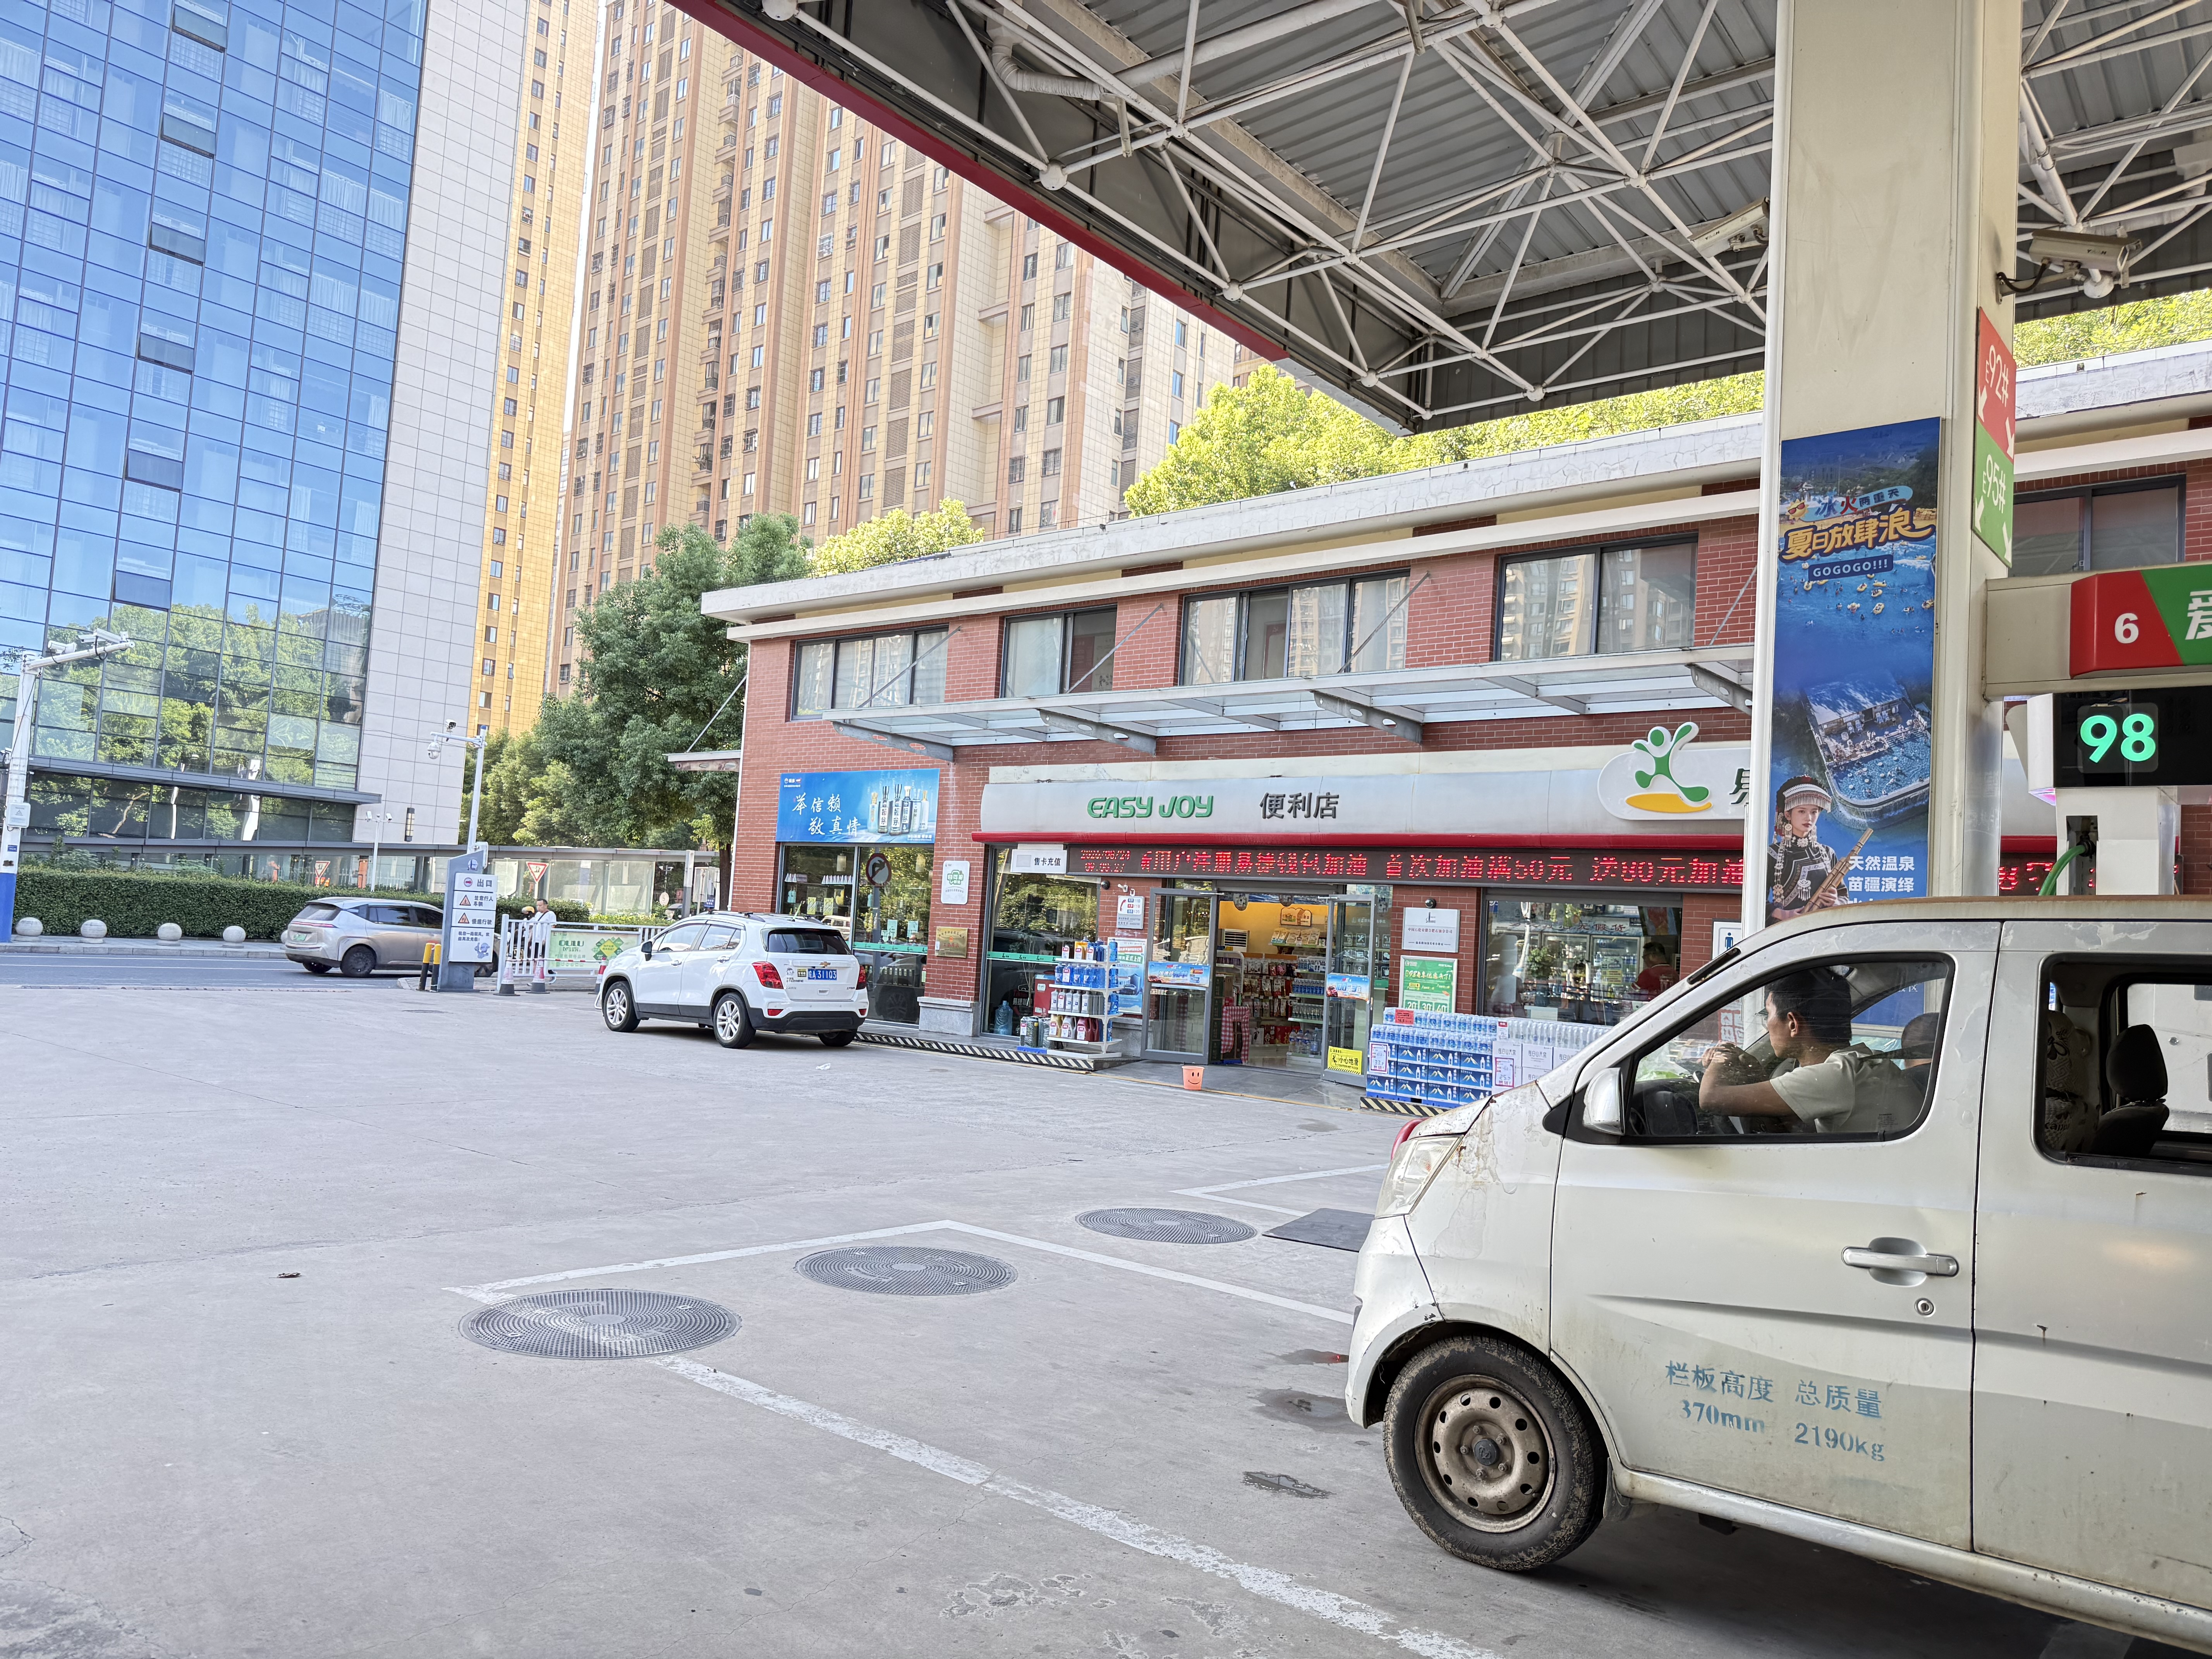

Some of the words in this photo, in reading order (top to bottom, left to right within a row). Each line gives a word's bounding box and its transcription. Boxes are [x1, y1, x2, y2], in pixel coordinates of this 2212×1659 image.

[1985, 345, 2009, 407] E92#
[1982, 454, 2006, 514] E95#
[1815, 488, 1899, 515] 冰火两重天
[1782, 507, 1932, 560] 夏日放肆浪
[1813, 558, 1888, 577] GOGOGO!!!
[2114, 613, 2139, 644] 6
[2080, 713, 2156, 764] 98
[792, 792, 841, 815] 举信赖
[1087, 796, 1153, 818] EASY
[1159, 795, 1214, 818] JOY
[1260, 792, 1339, 819] 便利店
[808, 816, 860, 838] 敬真情
[1034, 857, 1061, 867] 售卡充值
[1849, 855, 1915, 871] 天然温泉
[477, 878, 492, 888] 出口
[1848, 877, 1915, 892] 苗疆演绎
[1339, 1056, 1358, 1066] 小心地滑
[1665, 1360, 1774, 1403] 栏板高度
[1795, 1379, 1882, 1419] 总质量
[1682, 1399, 1765, 1433] 370mm
[1795, 1422, 1885, 1462] 2190kg
